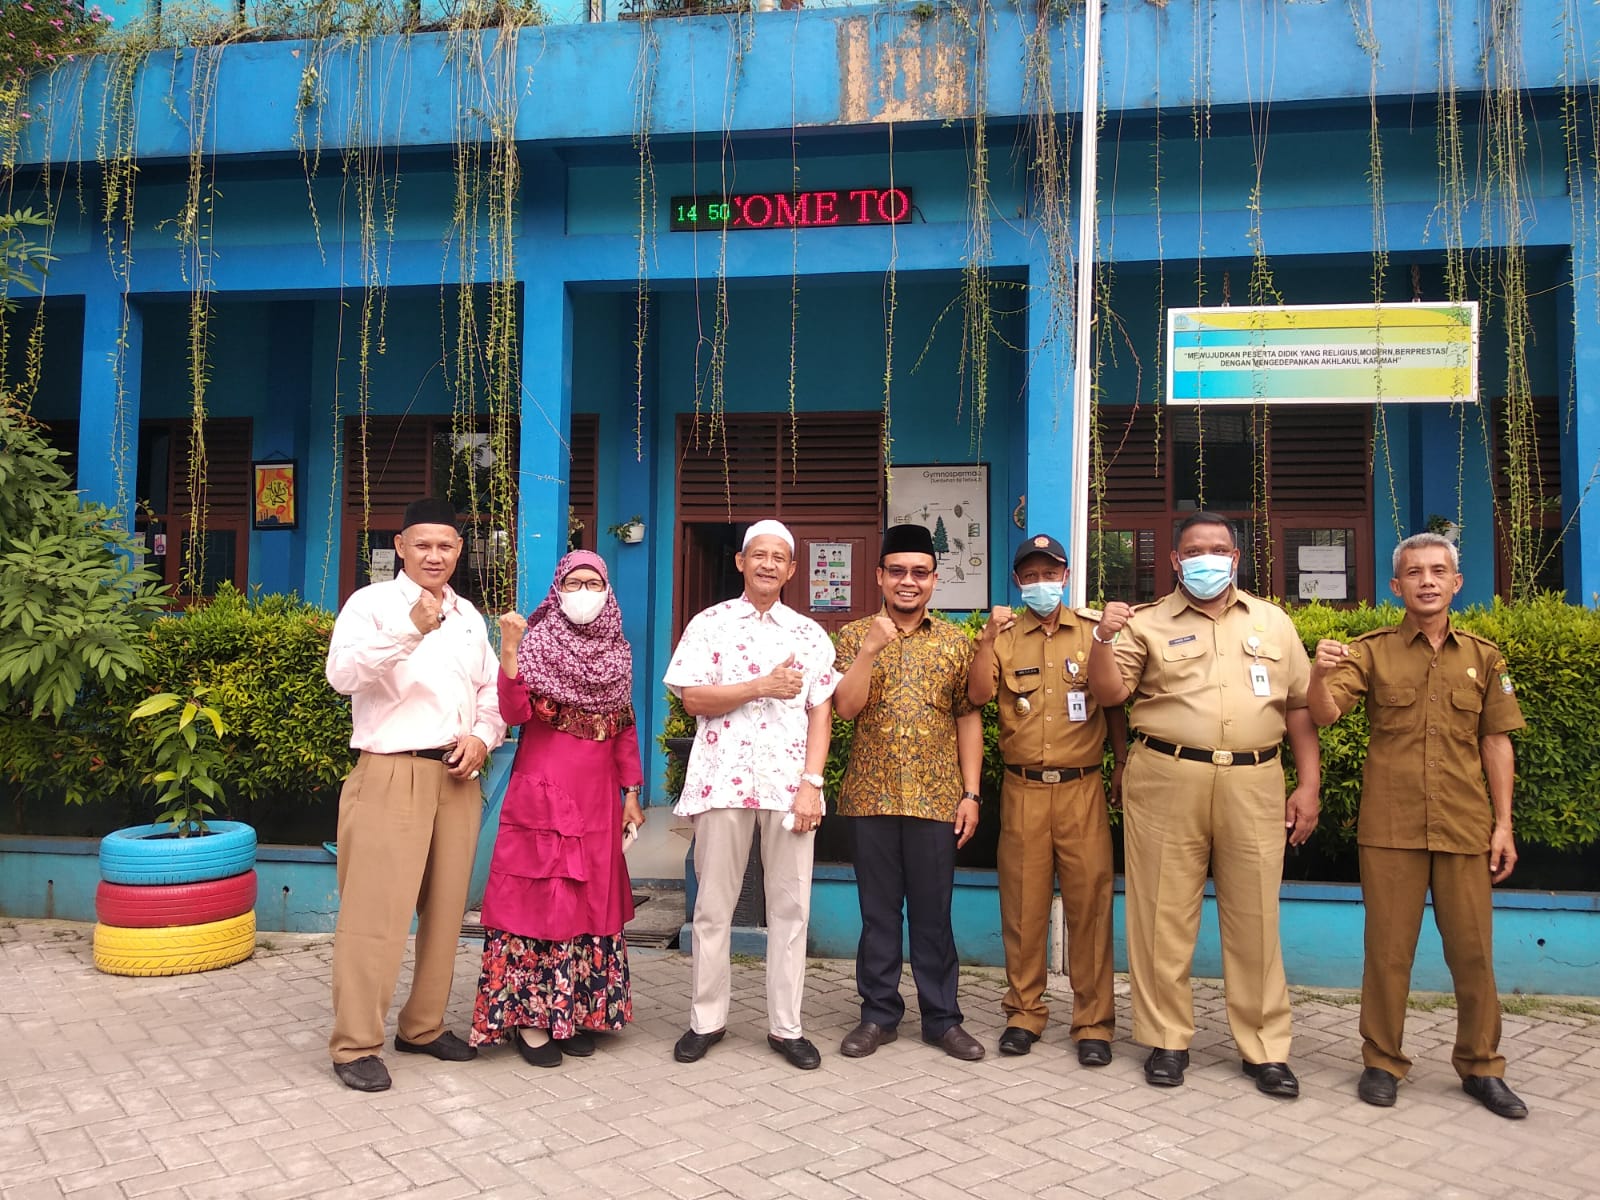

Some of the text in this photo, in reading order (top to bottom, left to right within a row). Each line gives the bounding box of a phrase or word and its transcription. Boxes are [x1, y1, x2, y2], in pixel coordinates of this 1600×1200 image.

[677, 204, 730, 221] 14 50
[850, 189, 909, 222] TO
[1242, 350, 1277, 358] PESERTA
[1277, 350, 1299, 358] DIDIK
[1300, 349, 1321, 357] YANG
[1220, 356, 1401, 367] DENGAN MENGEDEPANKAN AKHLAKUL KARMAH"
